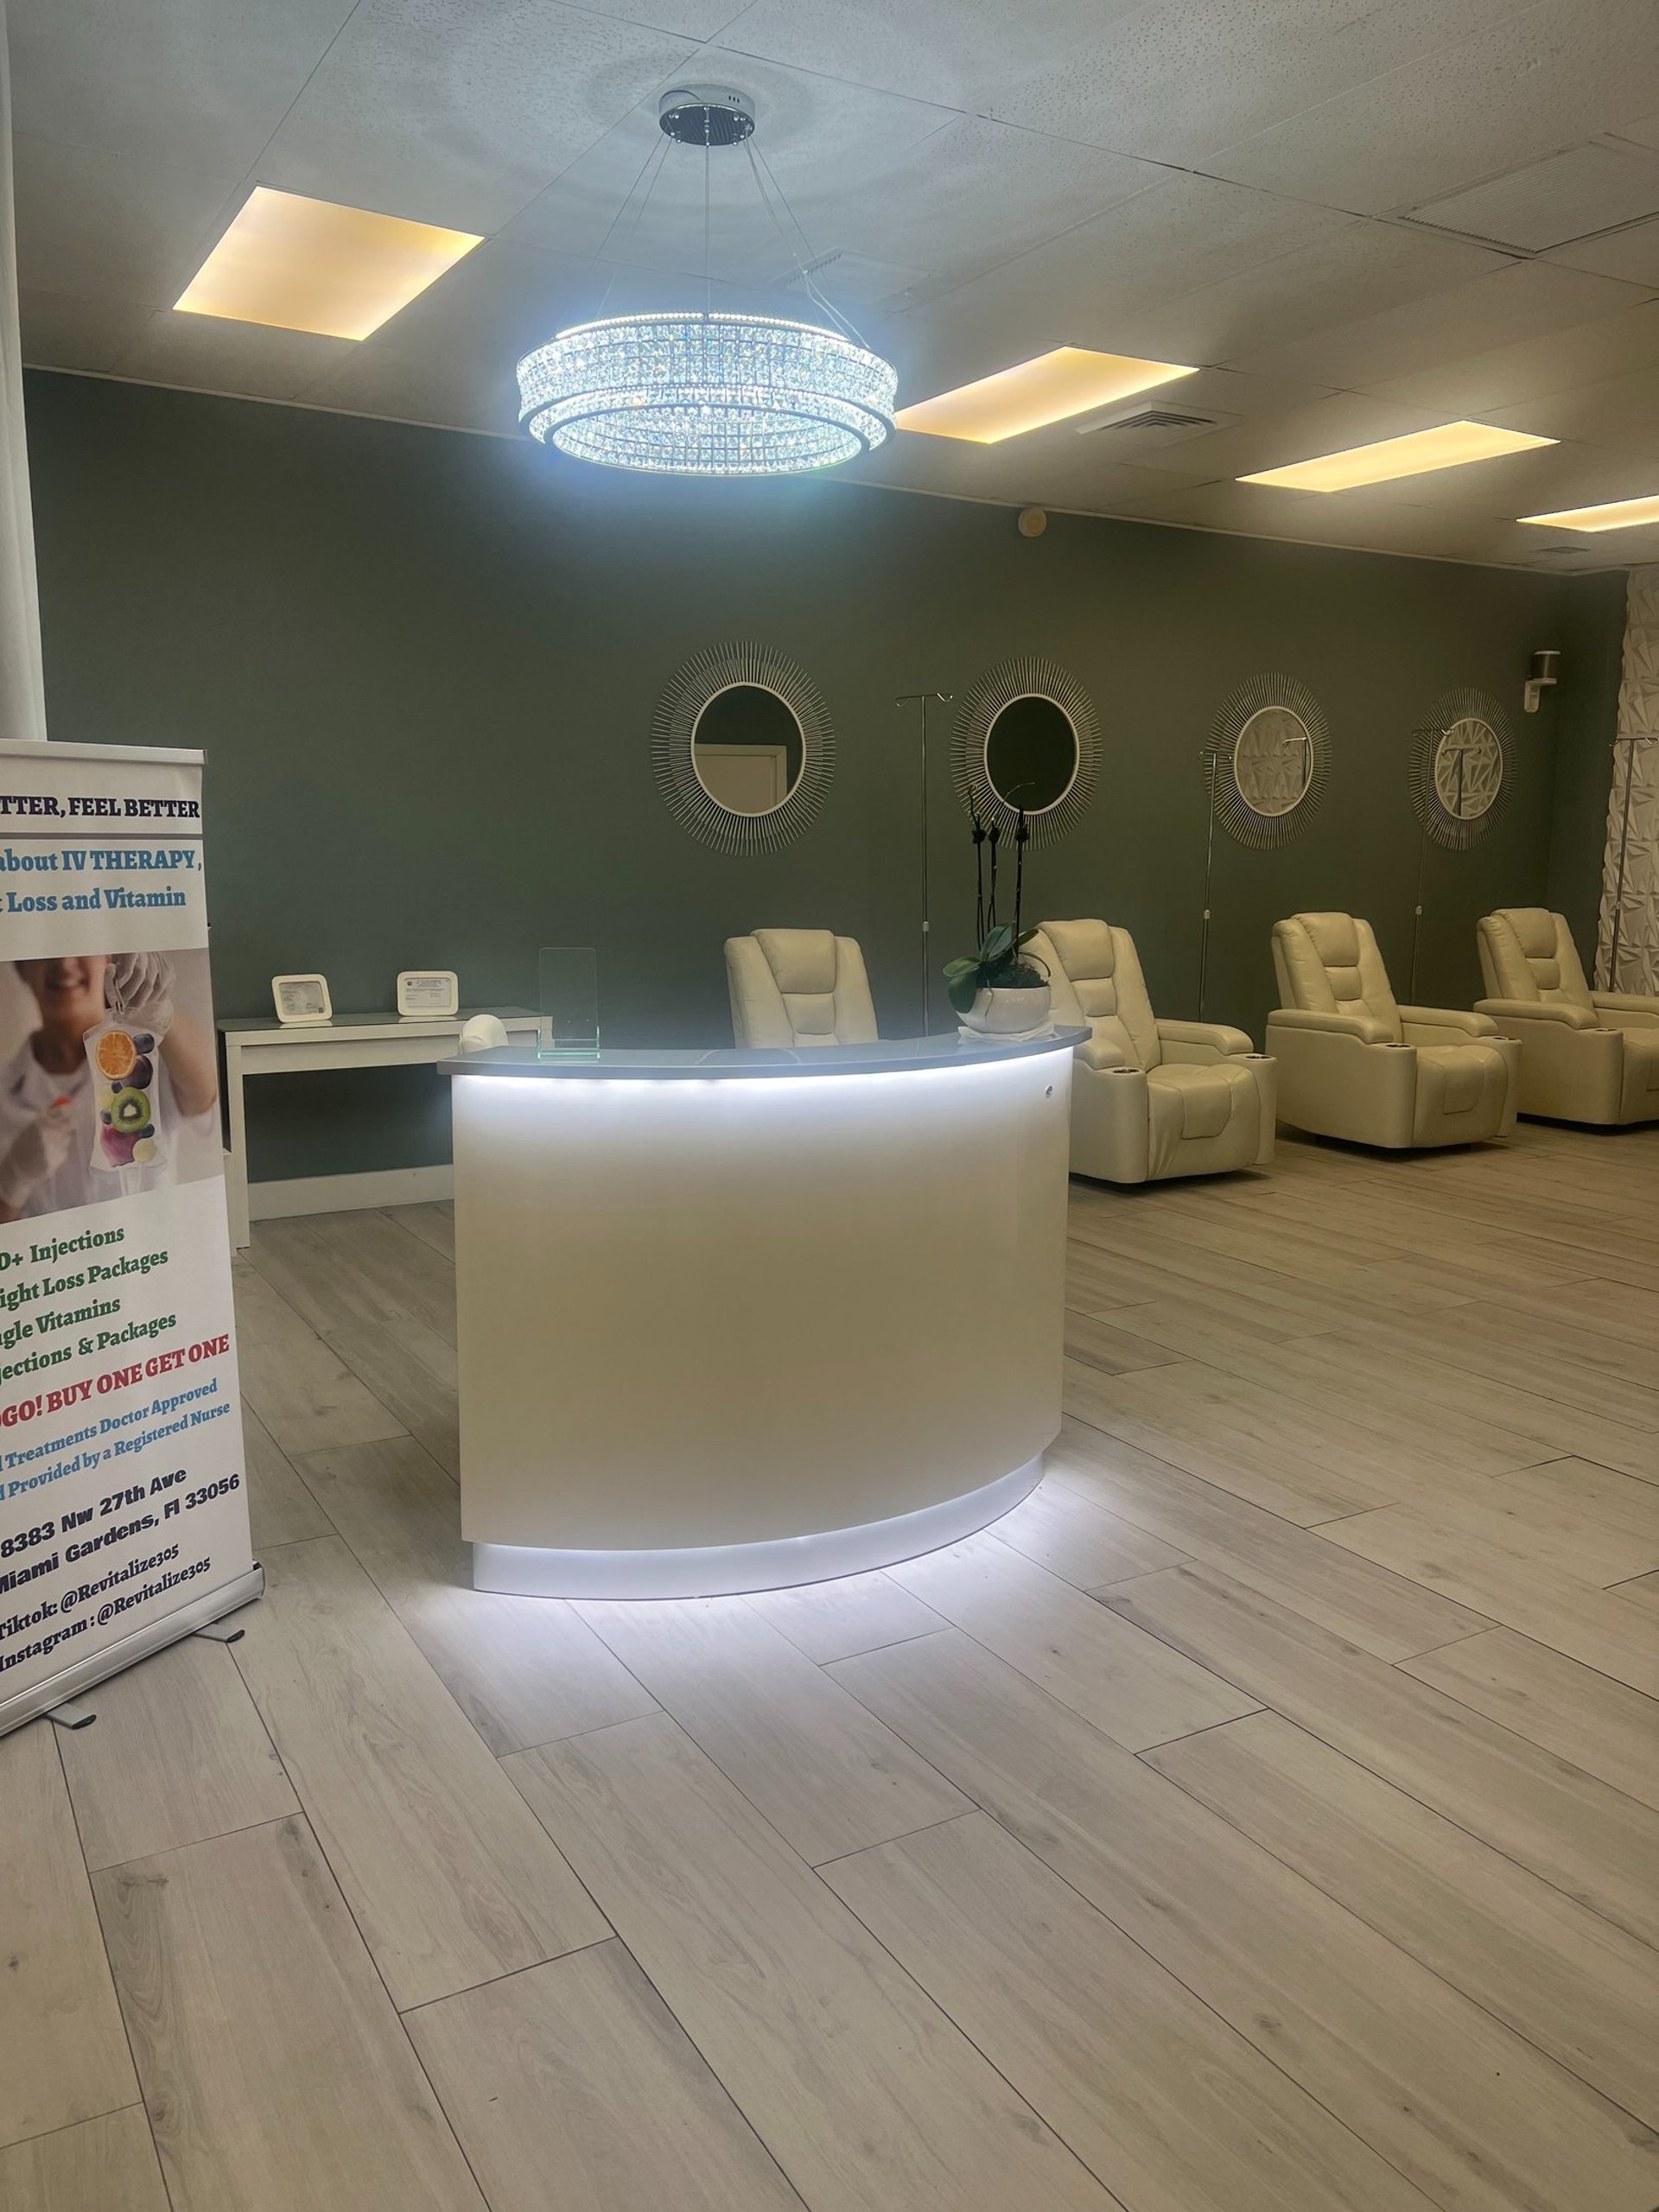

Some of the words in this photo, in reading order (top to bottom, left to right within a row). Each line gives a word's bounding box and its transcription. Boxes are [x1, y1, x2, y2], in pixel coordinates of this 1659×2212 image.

[0, 796, 66, 818] TTER,
[67, 797, 121, 817] FEEL
[124, 798, 200, 818] BETTER
[0, 848, 59, 872] about
[61, 850, 86, 871] IV
[6, 892, 58, 912] Loss
[61, 887, 101, 910] and
[104, 886, 187, 908] Vitamin
[0, 1283, 40, 1312] ight
[42, 1273, 85, 1296] Loss
[87, 1250, 168, 1284] Packages
[29, 1227, 125, 1263] Injections
[0, 1346, 73, 1384] ections
[78, 1337, 94, 1356] &
[96, 1314, 177, 1351] Packages
[35, 1299, 120, 1334] Vitamins
[0, 1395, 43, 1427] GO!
[46, 1379, 95, 1414] BUY
[96, 1363, 143, 1395] ONE
[144, 1348, 187, 1378] GET
[188, 1333, 230, 1363] ONE
[4, 1425, 98, 1469] Treatments
[99, 1408, 150, 1433] Doctor
[150, 1377, 218, 1415] Approved
[8, 1455, 81, 1497] Provided
[81, 1451, 101, 1469] by
[103, 1448, 111, 1460] a
[113, 1414, 189, 1455] Registered
[189, 1402, 231, 1427] Nurse
[1, 1522, 55, 1559] 8383
[60, 1507, 94, 1533] Nw
[99, 1484, 146, 1517] 27th
[149, 1470, 188, 1496] Ave
[65, 1514, 161, 1563] Gardens,
[185, 1474, 240, 1510] 33056
[0, 1600, 58, 1640] Tiktok:
[60, 1544, 180, 1614] @Revitalize305
[0, 1618, 88, 1673] Instagram
[97, 1557, 213, 1625] @Revitalize305
